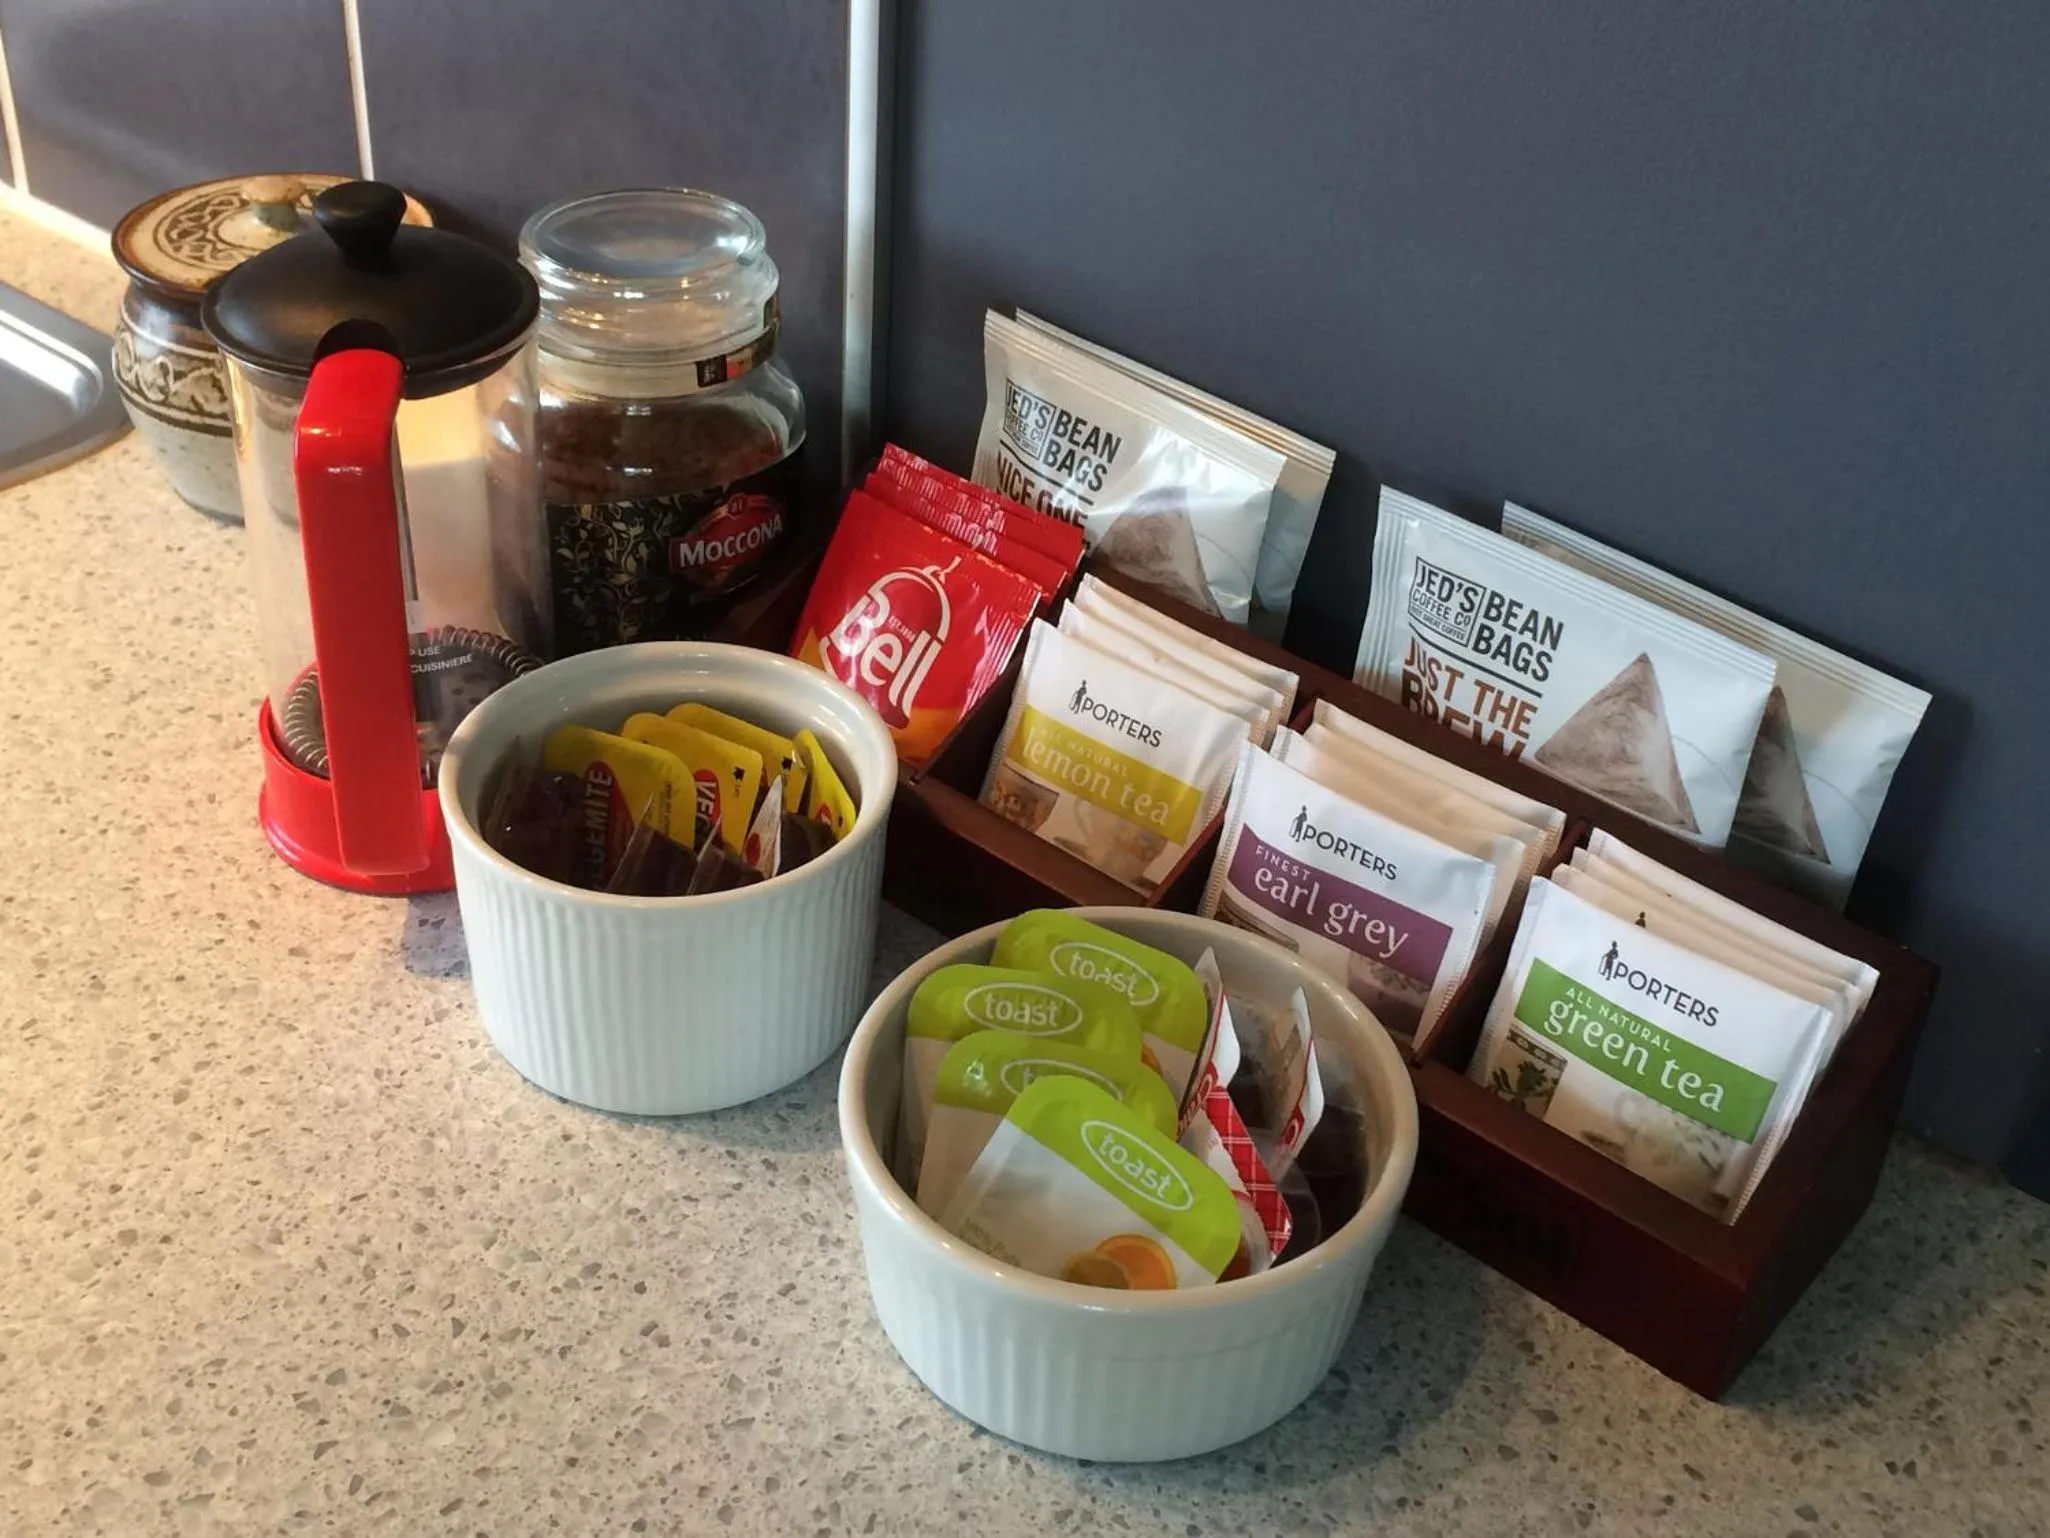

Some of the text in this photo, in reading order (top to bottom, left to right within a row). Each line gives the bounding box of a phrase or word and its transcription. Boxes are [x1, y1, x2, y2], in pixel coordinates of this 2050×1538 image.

[1042, 438, 1107, 492] BAGS
[1052, 409, 1122, 464] BEAN
[679, 512, 784, 567] MOCCONA
[1412, 588, 1452, 620] COFFEE
[1416, 565, 1478, 613] JED'S
[1483, 590, 1564, 651] BEAN
[829, 590, 942, 719] Bell
[1472, 622, 1553, 682] BAGS
[1404, 636, 1538, 739] JUST THE
[1081, 697, 1162, 748] PORTERS
[1023, 726, 1169, 826] lemon tea
[1255, 844, 1311, 881] FINEST
[1302, 825, 1397, 881] PORTERS
[1255, 866, 1409, 959] earl grey
[1070, 950, 1139, 998] toast
[1613, 962, 1719, 1027] PORTERS
[984, 993, 1060, 1028] toast
[1565, 987, 1672, 1052] ALL NATURAL
[1544, 999, 1725, 1112] green tea
[1097, 1131, 1173, 1200] toast
